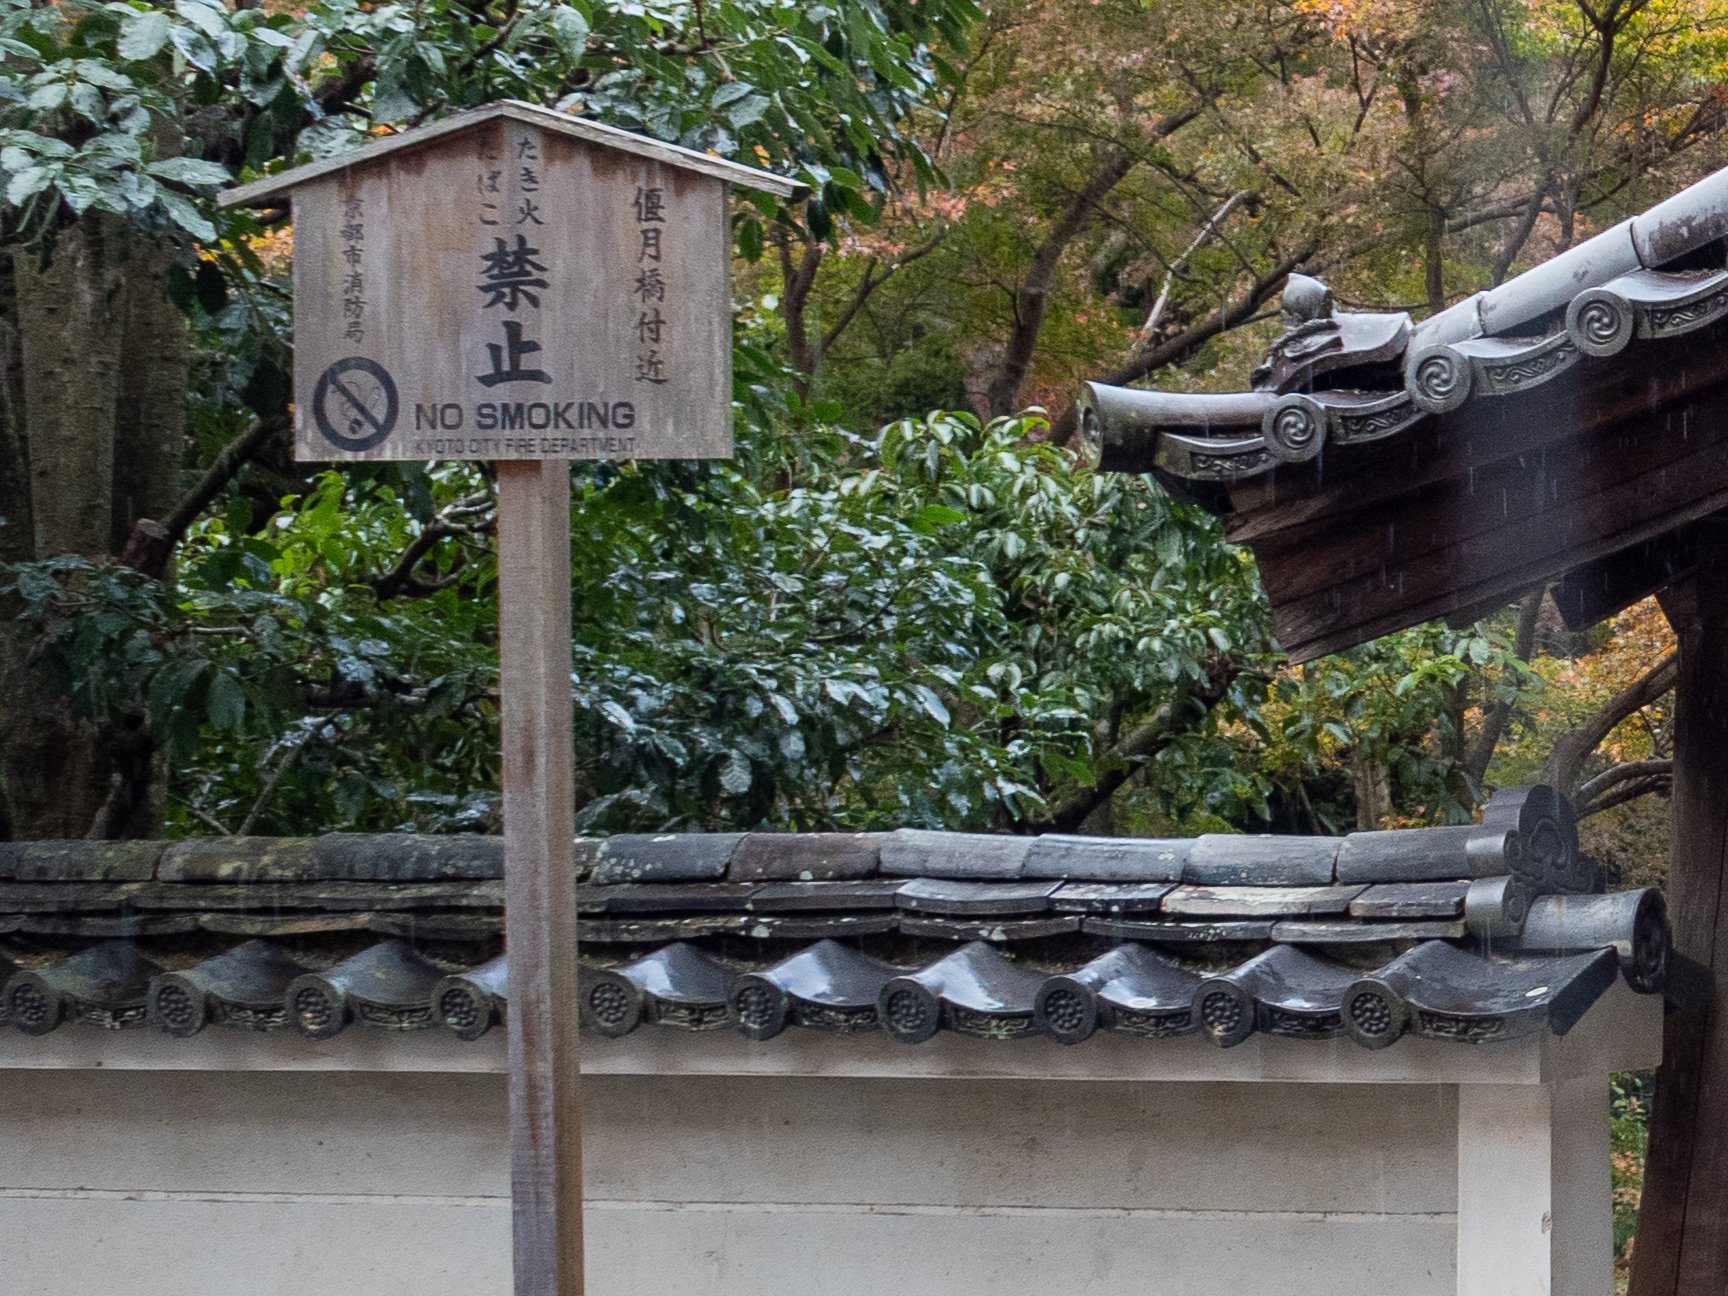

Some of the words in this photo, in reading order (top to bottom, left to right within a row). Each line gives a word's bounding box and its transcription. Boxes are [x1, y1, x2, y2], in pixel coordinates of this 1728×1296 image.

[517, 137, 544, 224] たき火
[339, 196, 367, 344] 京都市消防局
[476, 234, 553, 390] 禁止
[632, 186, 668, 385] 偃月橋付近
[415, 403, 464, 431] NO
[476, 402, 636, 431] SMOKING
[416, 438, 464, 455] KYOTO
[469, 438, 500, 455] CITY
[505, 438, 536, 454] FIRE
[541, 437, 636, 454] DEPARTMENT
